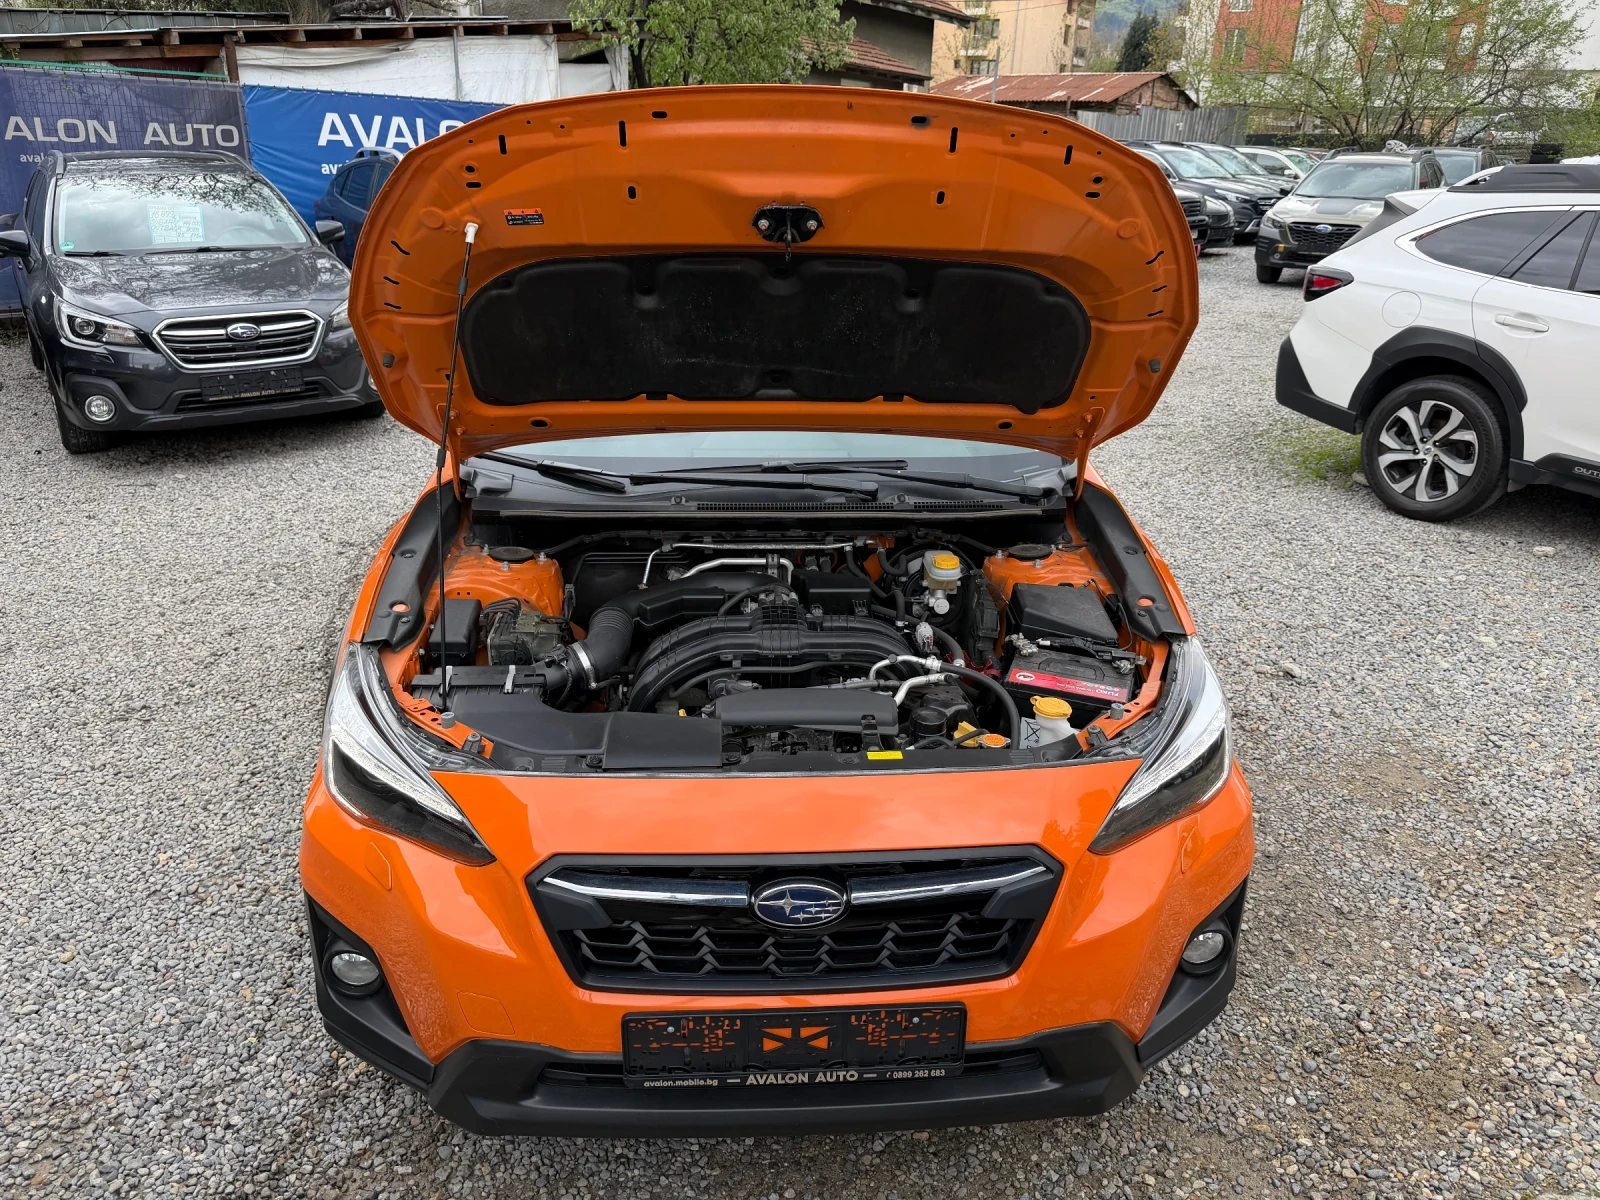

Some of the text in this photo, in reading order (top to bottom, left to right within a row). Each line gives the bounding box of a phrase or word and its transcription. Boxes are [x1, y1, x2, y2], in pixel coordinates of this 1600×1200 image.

[4, 115, 240, 147] ALON AUTO
[20, 152, 45, 163] aval
[1574, 466, 1600, 477] OUT
[643, 1078, 719, 1087] avalon.mobile.bg
[745, 1072, 809, 1085] AVALON
[815, 1070, 859, 1083] AUTO
[892, 1069, 912, 1079] 0899
[914, 1069, 929, 1078] 262
